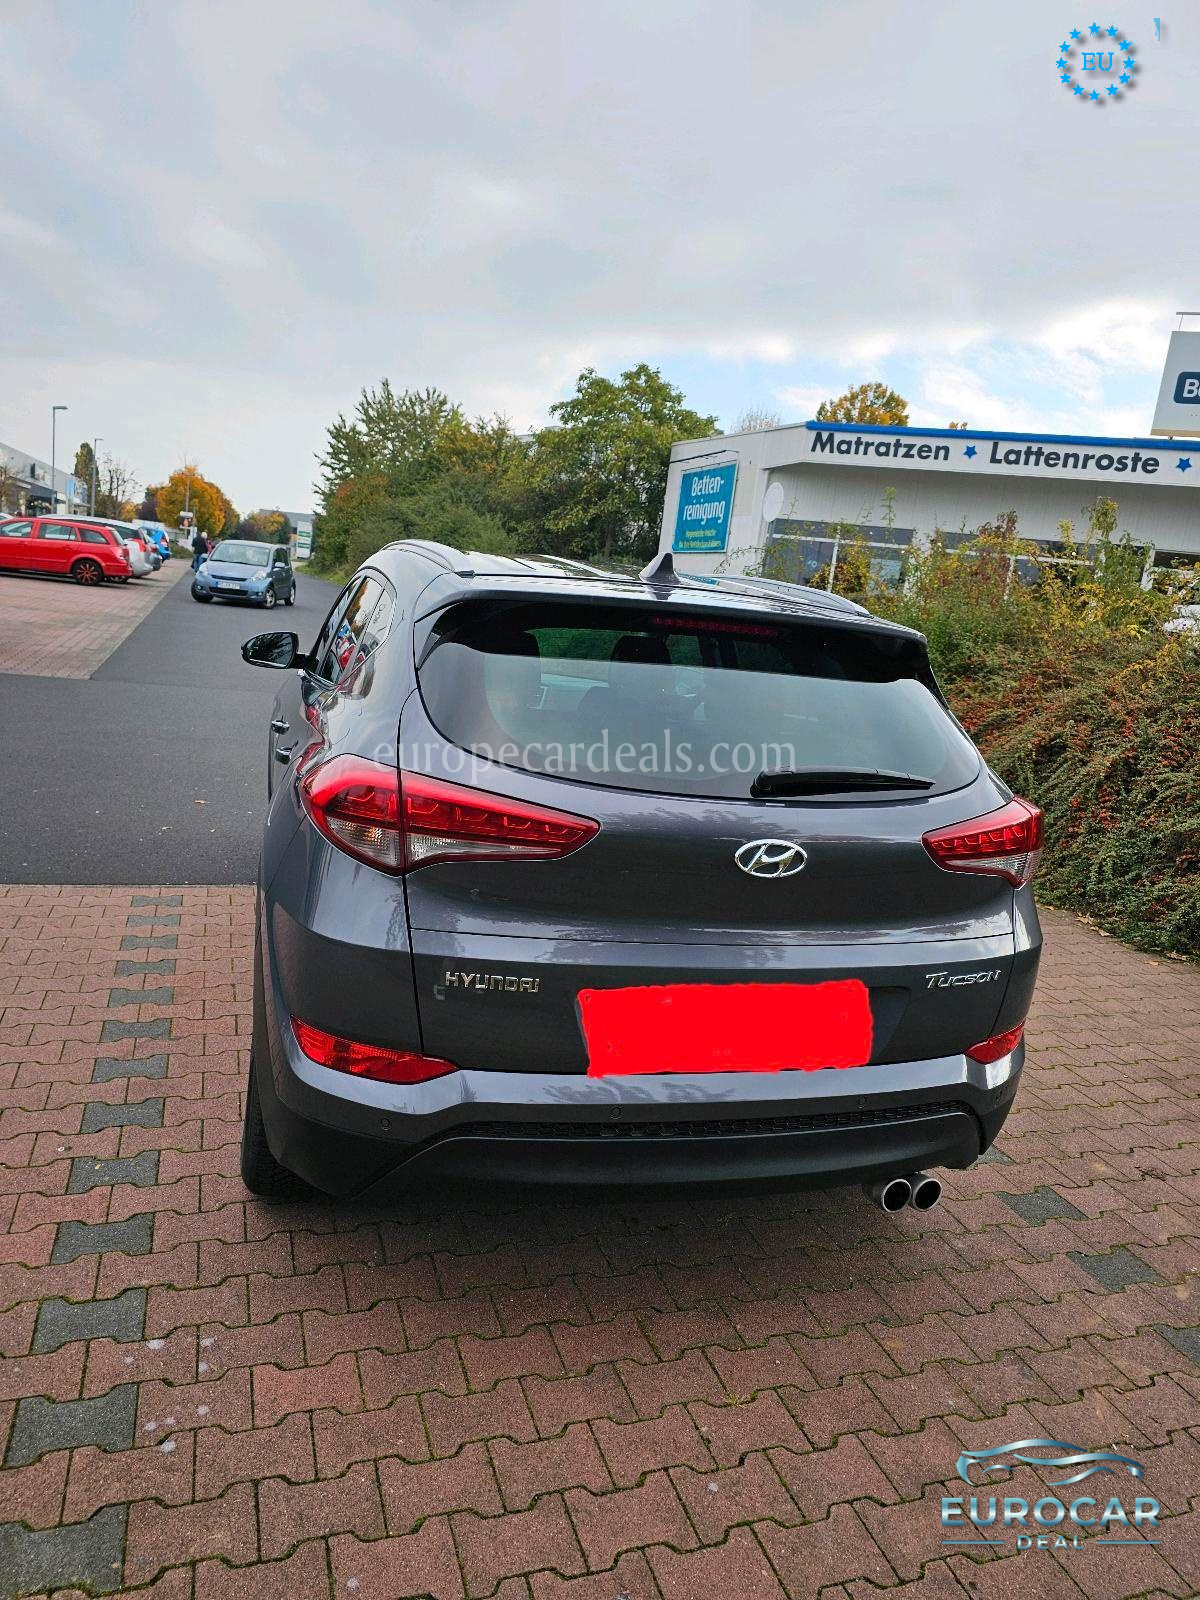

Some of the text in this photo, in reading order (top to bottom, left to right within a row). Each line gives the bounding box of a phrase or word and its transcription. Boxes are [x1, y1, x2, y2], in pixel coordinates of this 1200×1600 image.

[1183, 378, 1200, 398] B
[811, 431, 1160, 474] Matratzen Lattenroste
[691, 475, 725, 496] Betten-
[683, 499, 726, 525] reinigung
[445, 971, 540, 993] HYUNDAI
